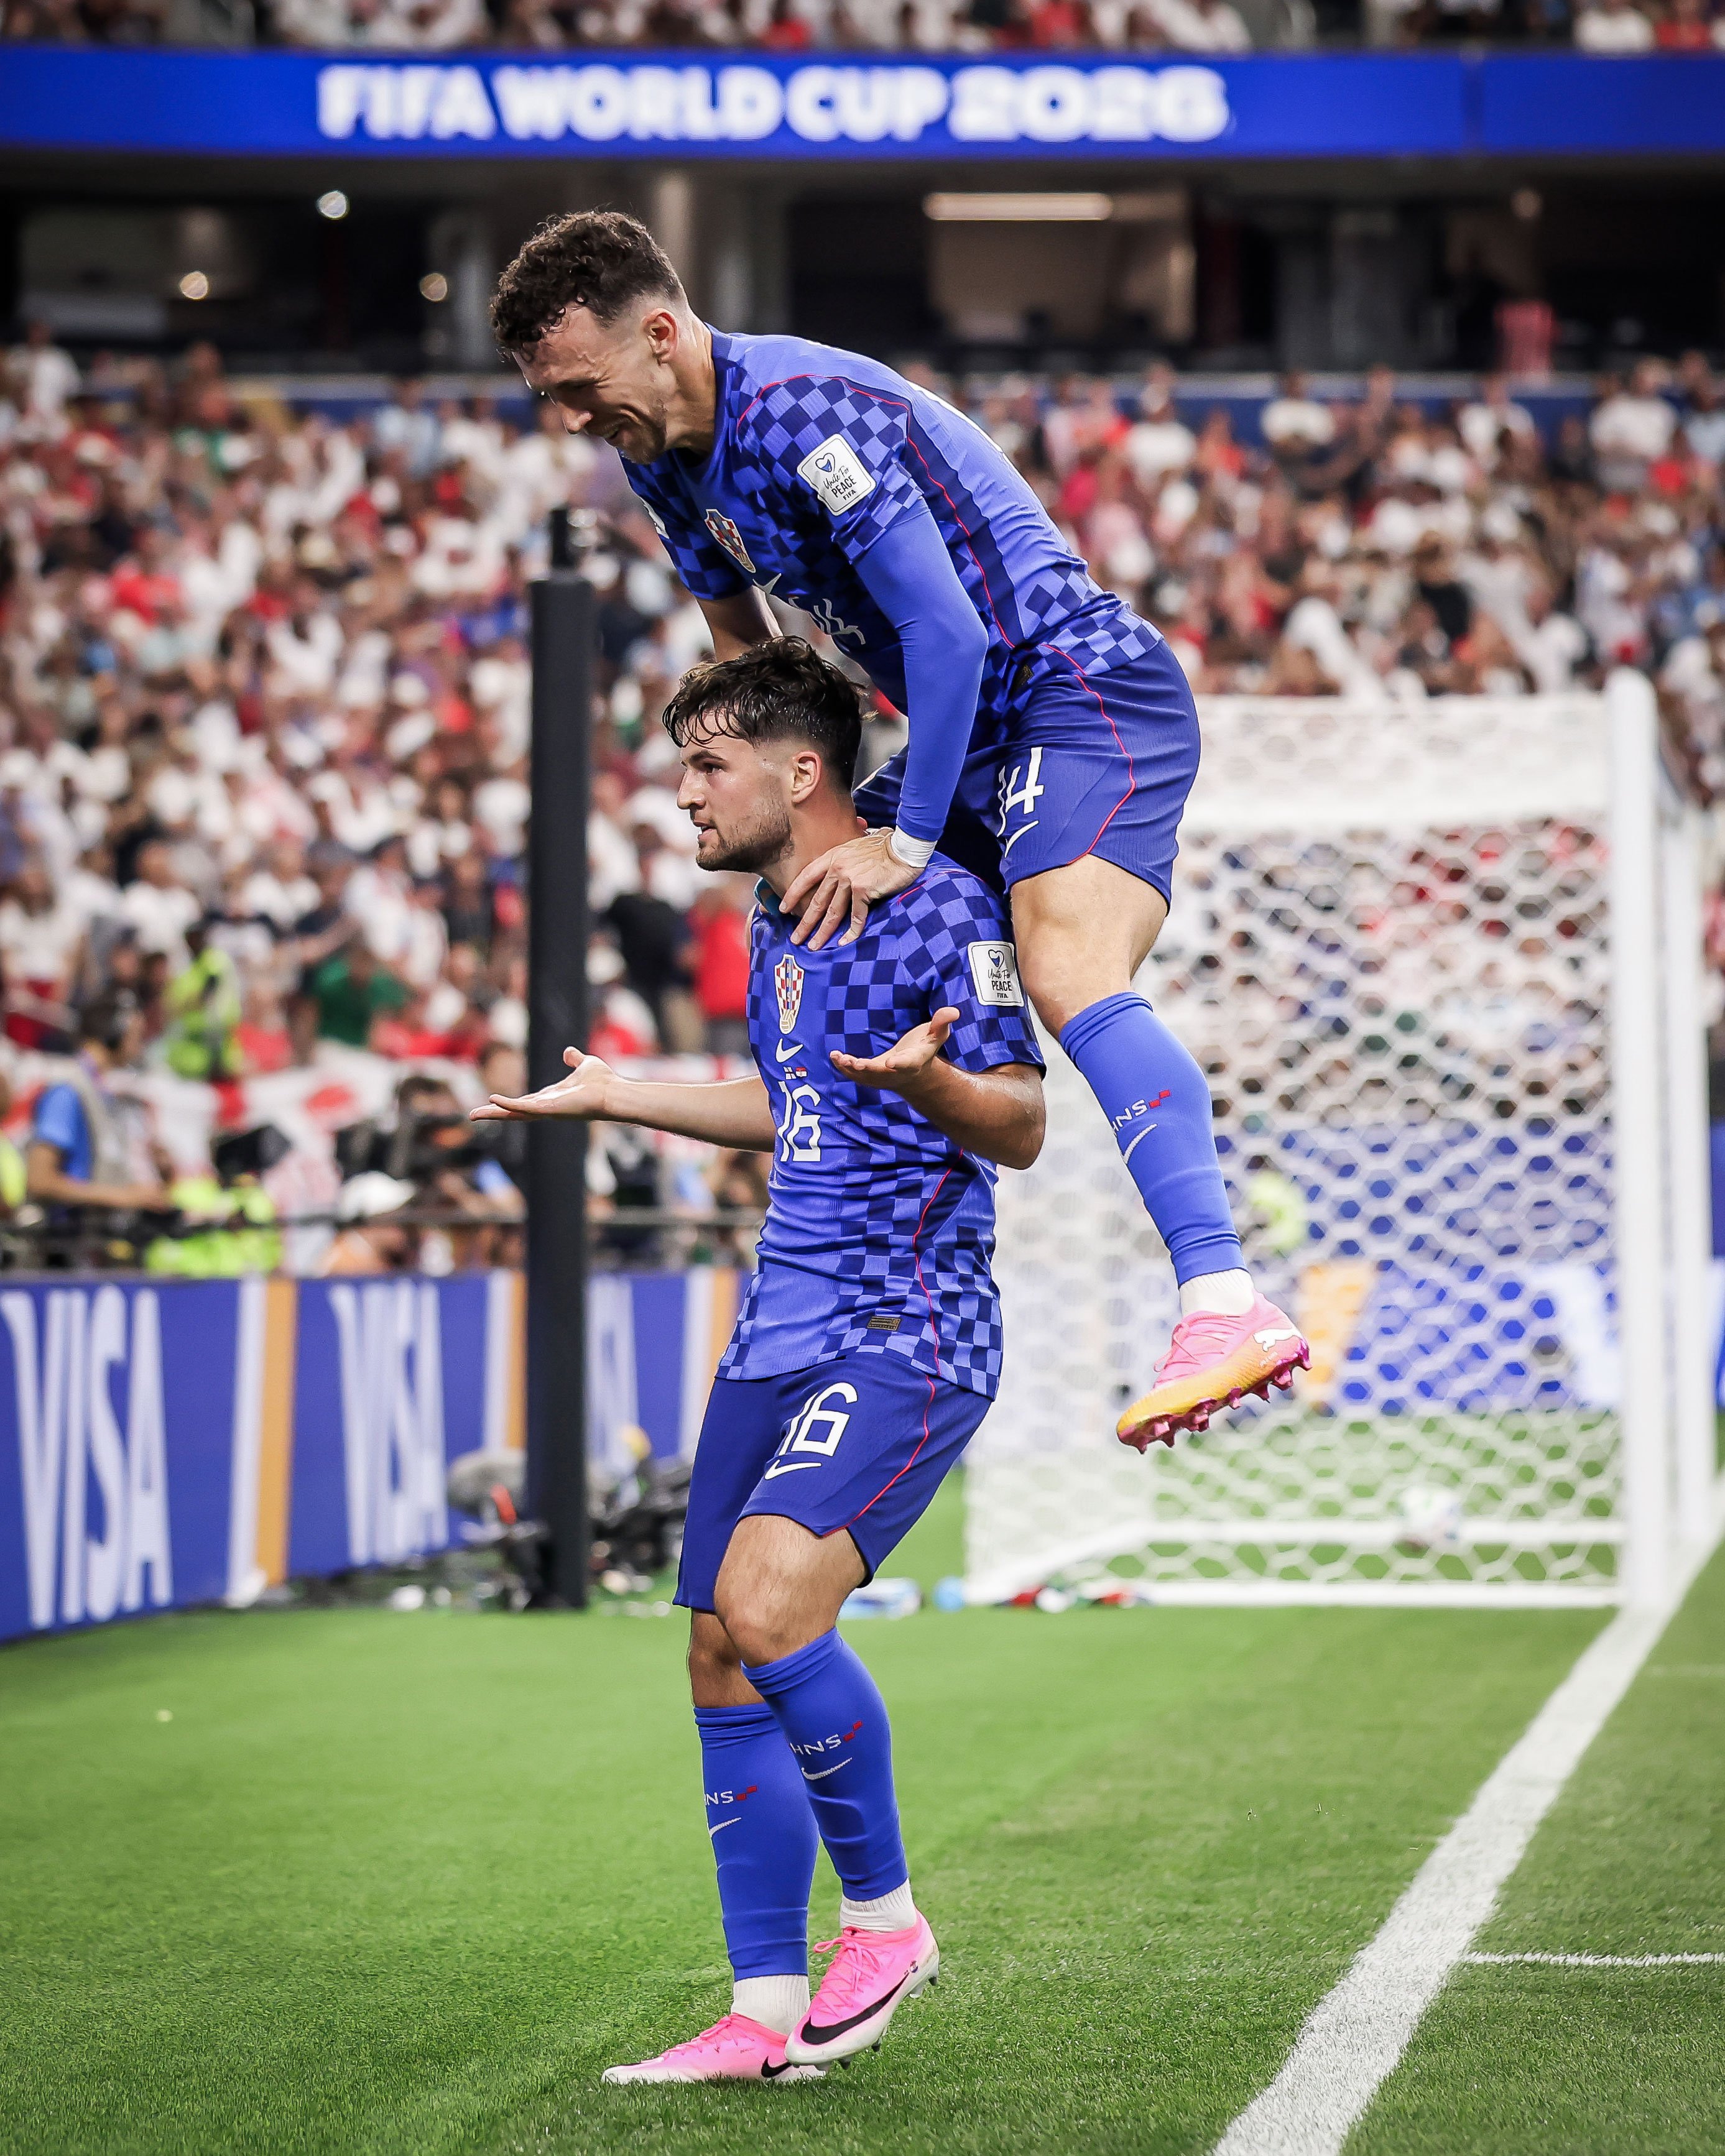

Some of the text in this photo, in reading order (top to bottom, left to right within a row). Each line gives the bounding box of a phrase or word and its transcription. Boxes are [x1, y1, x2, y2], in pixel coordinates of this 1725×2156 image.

[317, 65, 1231, 142] FIFA WORLD CUP 2026
[823, 465, 849, 490] Unite For
[831, 474, 857, 499] PEACE
[843, 489, 857, 501] FIFA
[991, 980, 1013, 991] PEACE
[777, 1080, 821, 1162] 16
[328, 1279, 449, 1566] VISA
[778, 1381, 858, 1457] 16
[2, 1286, 173, 1630] VISA
[790, 1733, 841, 1755] HNS
[704, 1790, 734, 1806] NS
